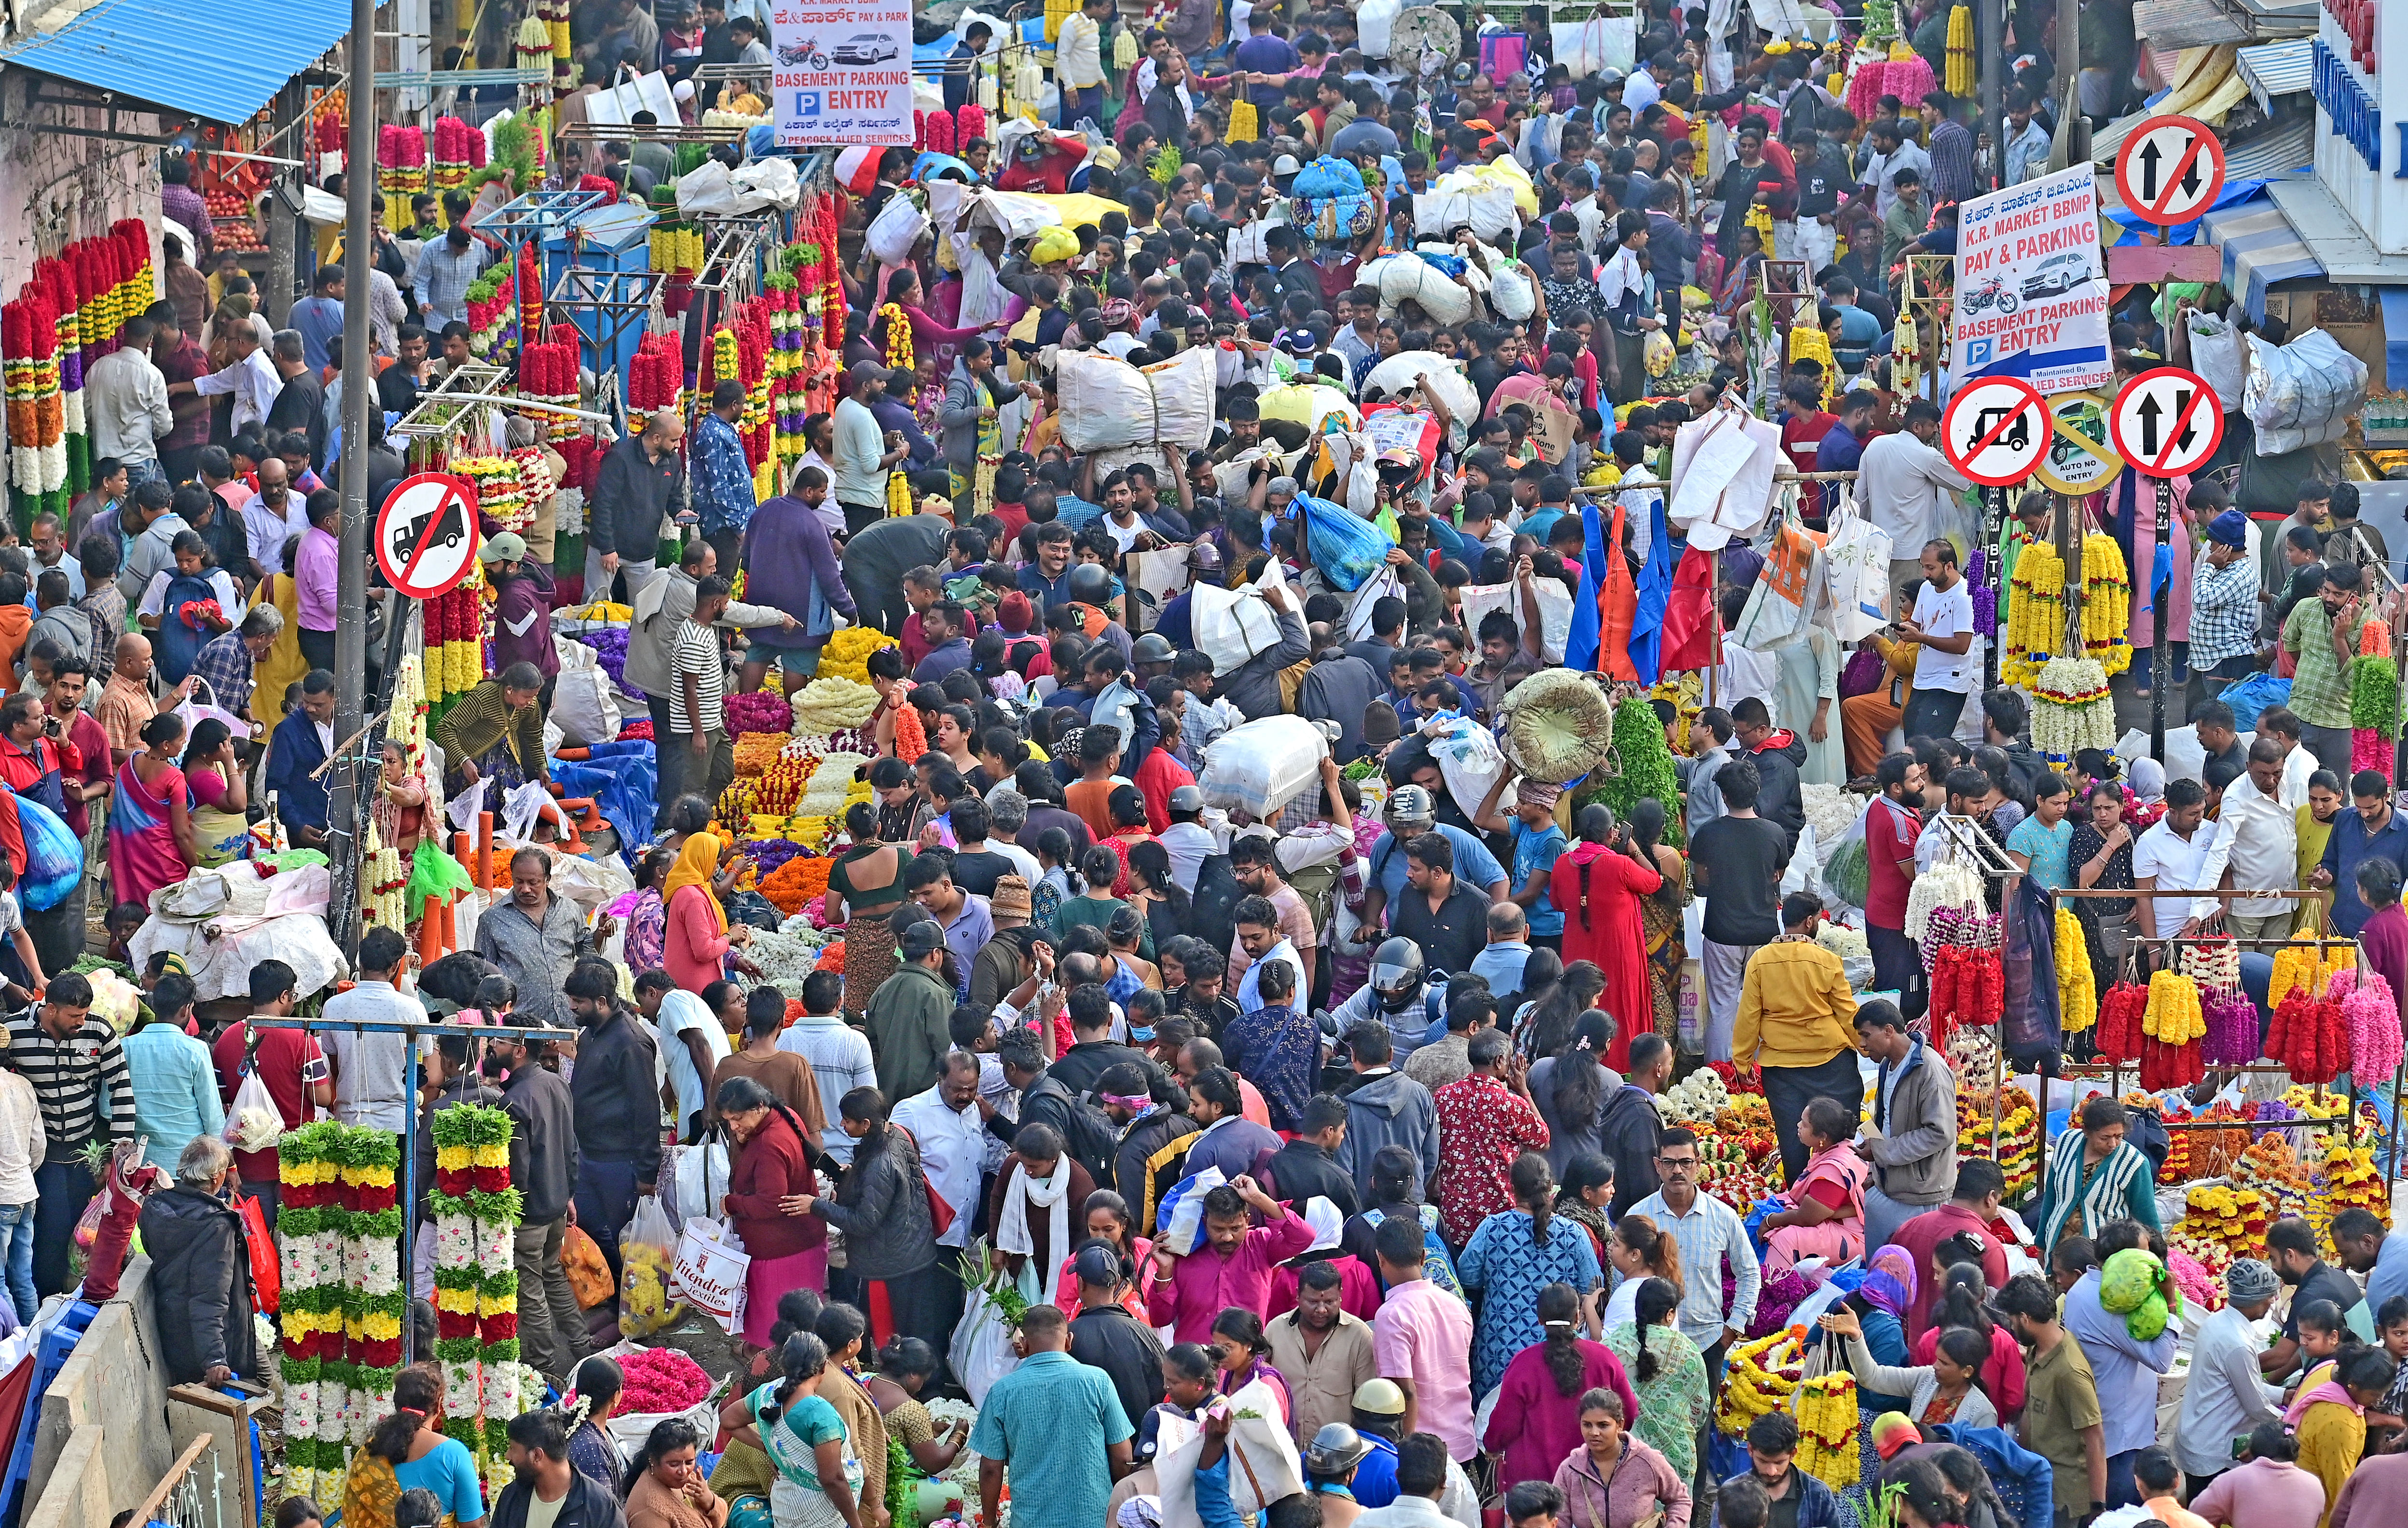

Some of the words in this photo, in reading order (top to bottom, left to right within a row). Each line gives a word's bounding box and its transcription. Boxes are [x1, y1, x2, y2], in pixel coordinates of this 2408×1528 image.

[858, 12, 874, 22] PAY
[877, 12, 883, 22] &
[885, 12, 908, 22] PARK
[775, 72, 846, 87] BASEMENT
[851, 71, 908, 85] PARKING
[828, 90, 889, 109] ENTRY
[788, 136, 833, 145] PEACOCK
[835, 135, 862, 143] ALIED
[866, 134, 911, 143] SERVICES
[1966, 225, 1991, 247] K.R.
[1994, 205, 2049, 237] MARKET
[2053, 194, 2091, 220] BBMP
[1965, 247, 1994, 276] PAY
[1998, 244, 2011, 265] &
[2017, 220, 2096, 261] PARKING
[1957, 309, 2036, 341] BASEMENT
[2040, 295, 2106, 323] PARKING
[1999, 322, 2062, 353] ENTRY
[2027, 381, 2056, 393] LIED
[2059, 371, 2113, 389] SERVICES
[2036, 366, 2075, 378] Maintained
[2060, 462, 2082, 472] AUTO
[2084, 460, 2097, 468] NO
[2065, 470, 2093, 482] ENTRY
[675, 1257, 731, 1296] Hitendra
[688, 1283, 727, 1307] Textiles
